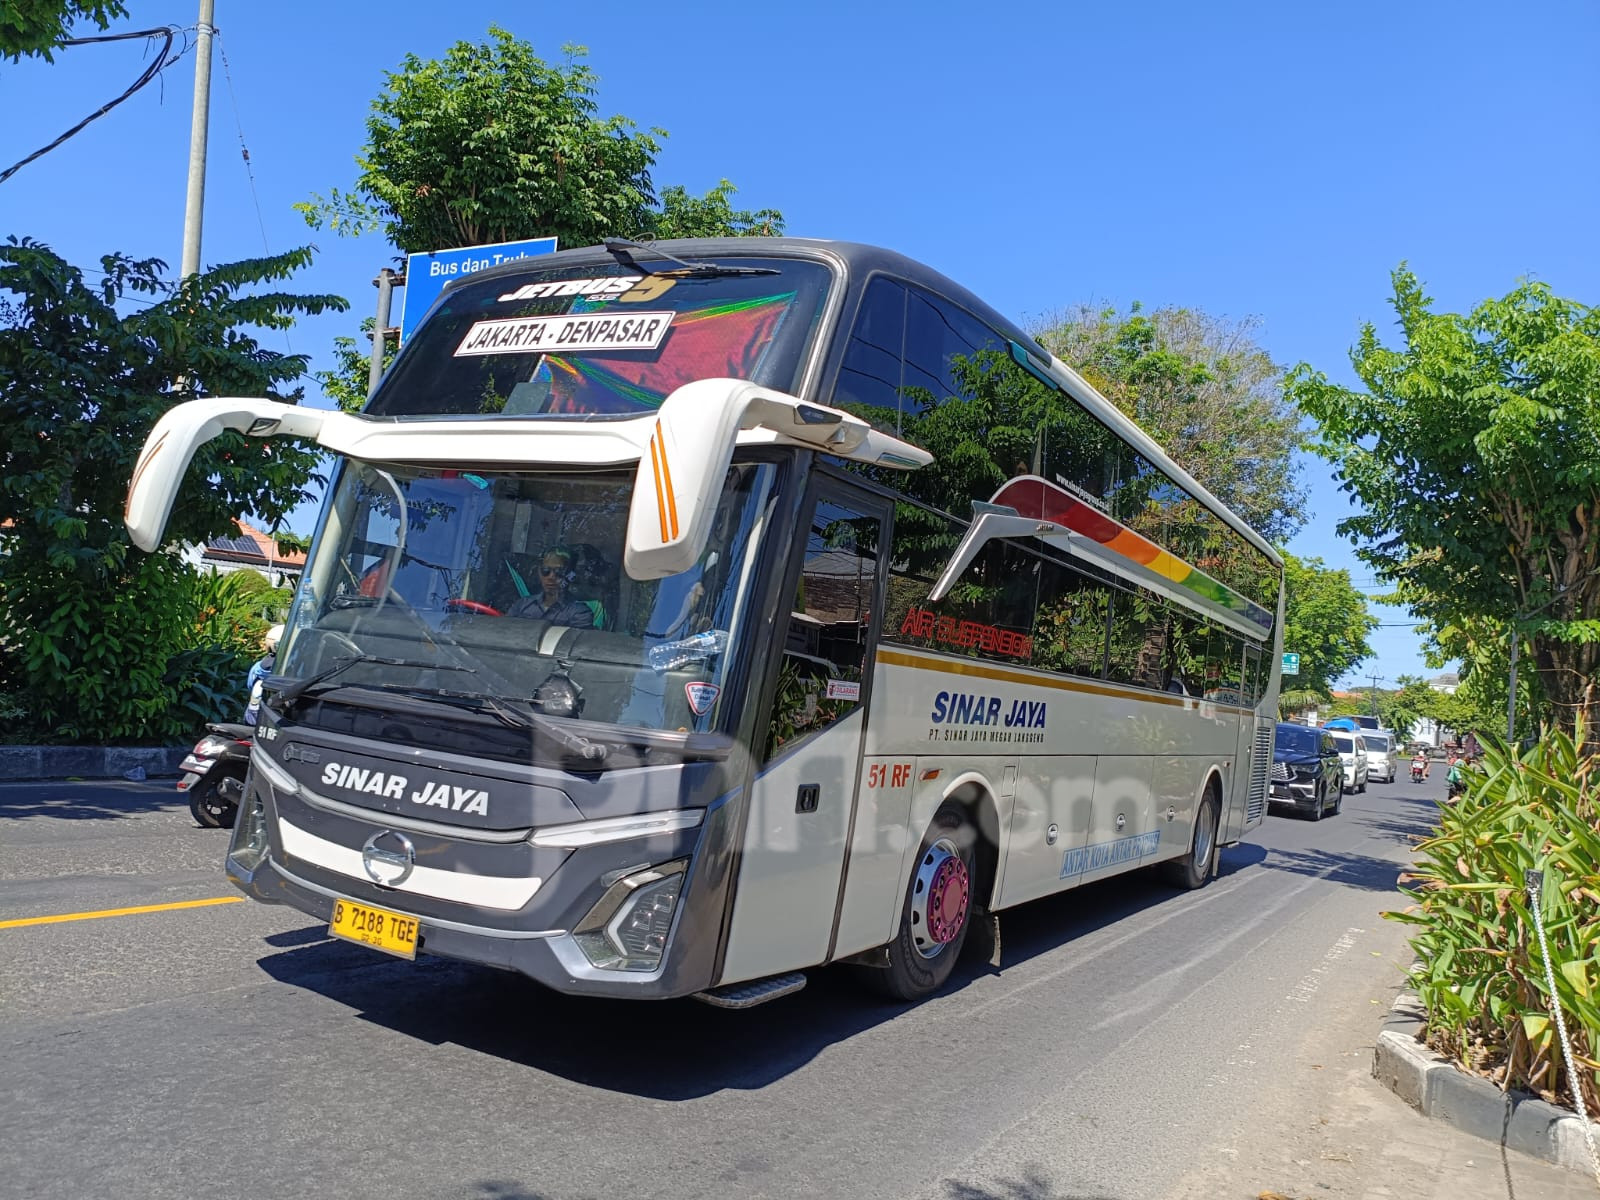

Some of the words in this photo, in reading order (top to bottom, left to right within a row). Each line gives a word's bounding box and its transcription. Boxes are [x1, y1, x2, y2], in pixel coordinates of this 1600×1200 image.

[430, 261, 458, 276] Bus
[461, 257, 490, 273] dan
[467, 323, 547, 350] JAKARTA
[556, 318, 661, 344] DENPASAR
[901, 608, 936, 638] AIR
[931, 691, 1002, 726] SINAR
[1004, 699, 1047, 728] JAYA
[321, 762, 408, 800] SINAR
[411, 781, 489, 816] JAYA
[868, 763, 887, 788] 51
[891, 763, 912, 788] RF
[334, 904, 344, 924] B
[351, 907, 384, 934] 7188
[391, 917, 415, 943] TGE
